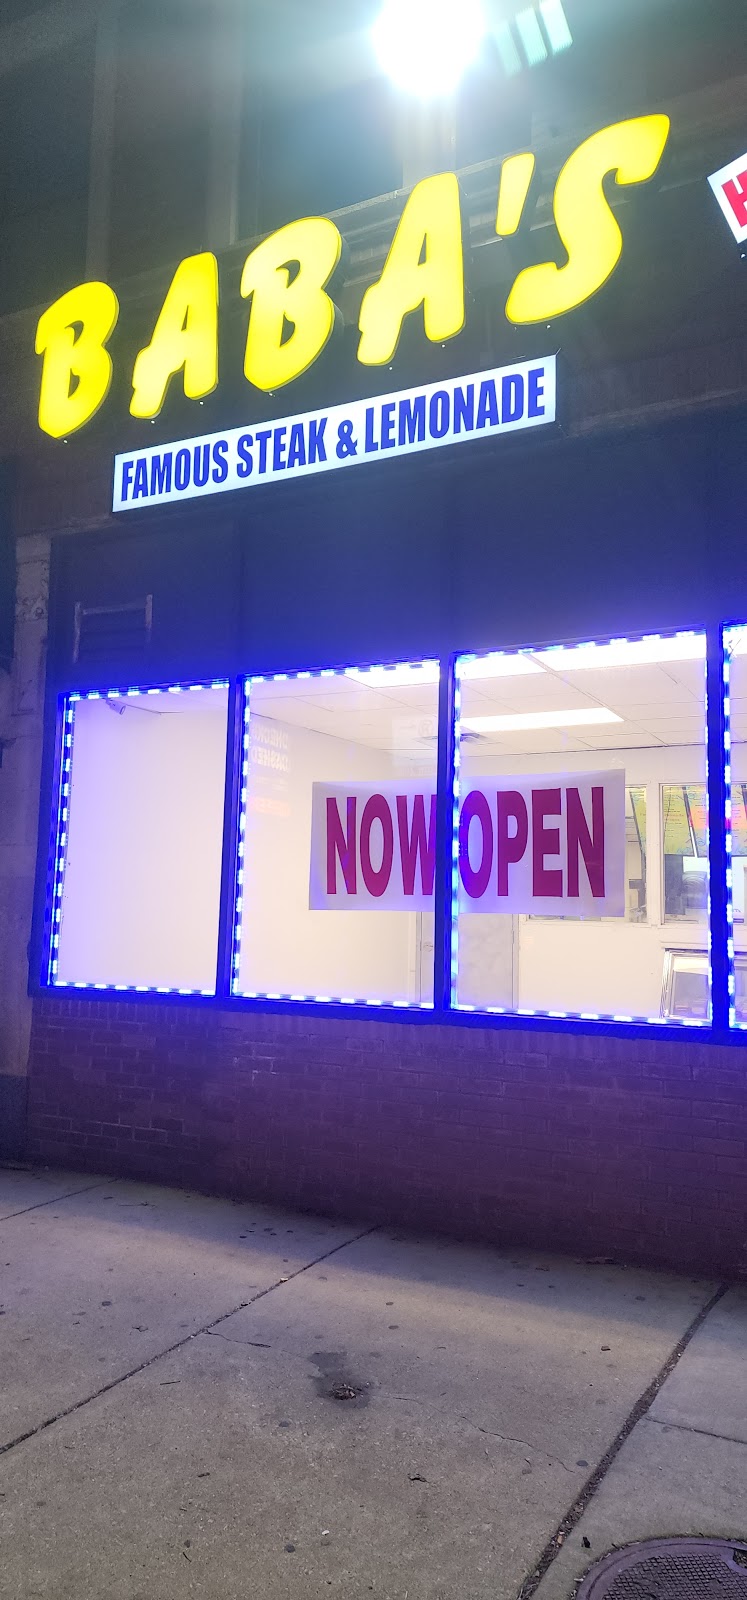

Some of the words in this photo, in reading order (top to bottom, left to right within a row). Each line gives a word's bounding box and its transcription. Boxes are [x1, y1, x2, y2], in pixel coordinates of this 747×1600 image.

[35, 113, 670, 439] BABA'S
[120, 439, 229, 502] FAMOUS
[236, 416, 328, 479] STEAK
[335, 419, 358, 460] &
[364, 366, 546, 454] LEMONADE
[326, 793, 438, 898] NOW
[458, 786, 606, 899] OPEN
